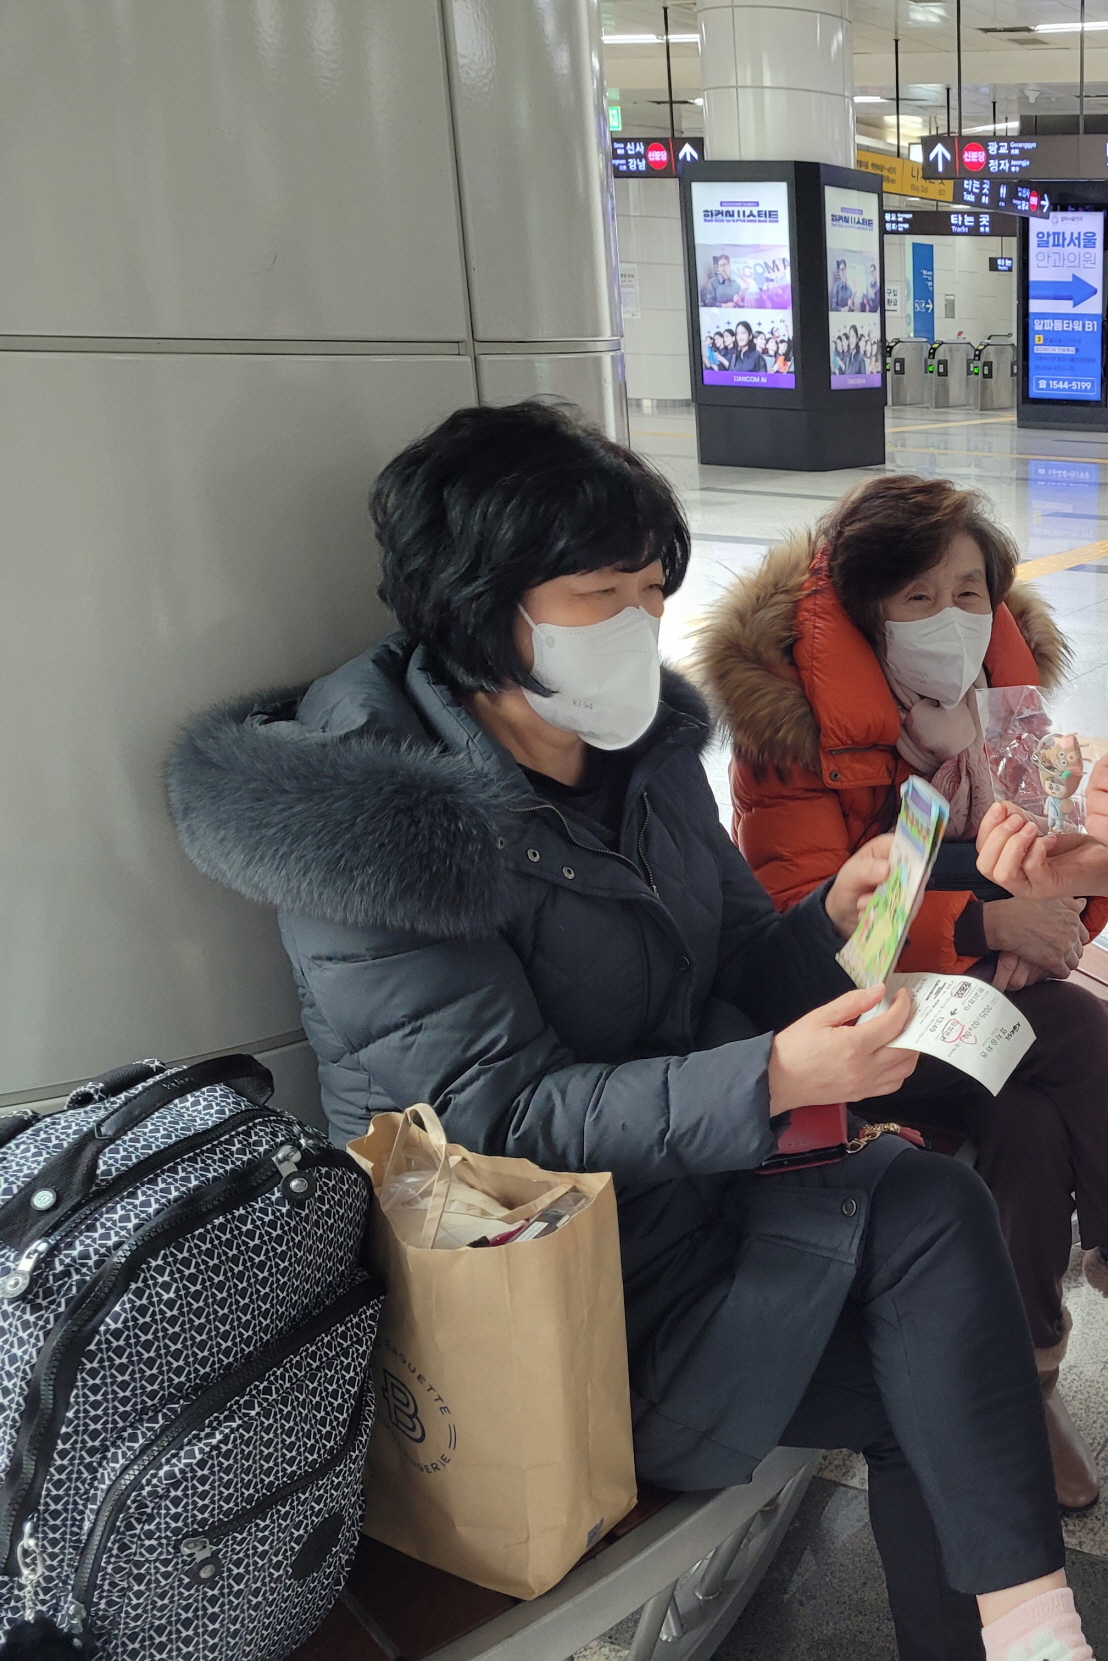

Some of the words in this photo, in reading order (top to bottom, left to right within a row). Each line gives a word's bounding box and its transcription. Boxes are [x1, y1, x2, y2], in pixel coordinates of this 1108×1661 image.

[626, 142, 645, 155] 신사
[987, 142, 1009, 155] 광교
[962, 150, 985, 162] 신분당
[628, 158, 646, 171] 강남
[988, 159, 1010, 172] 정자
[950, 214, 974, 226] 타는
[979, 214, 990, 225] 곳
[1036, 231, 1097, 248] 알파서울
[1036, 251, 1096, 269] 안과의원
[1084, 321, 1098, 332] B1
[1049, 380, 1092, 390] 1544-5199
[928, 1016, 945, 1033] 13:49
